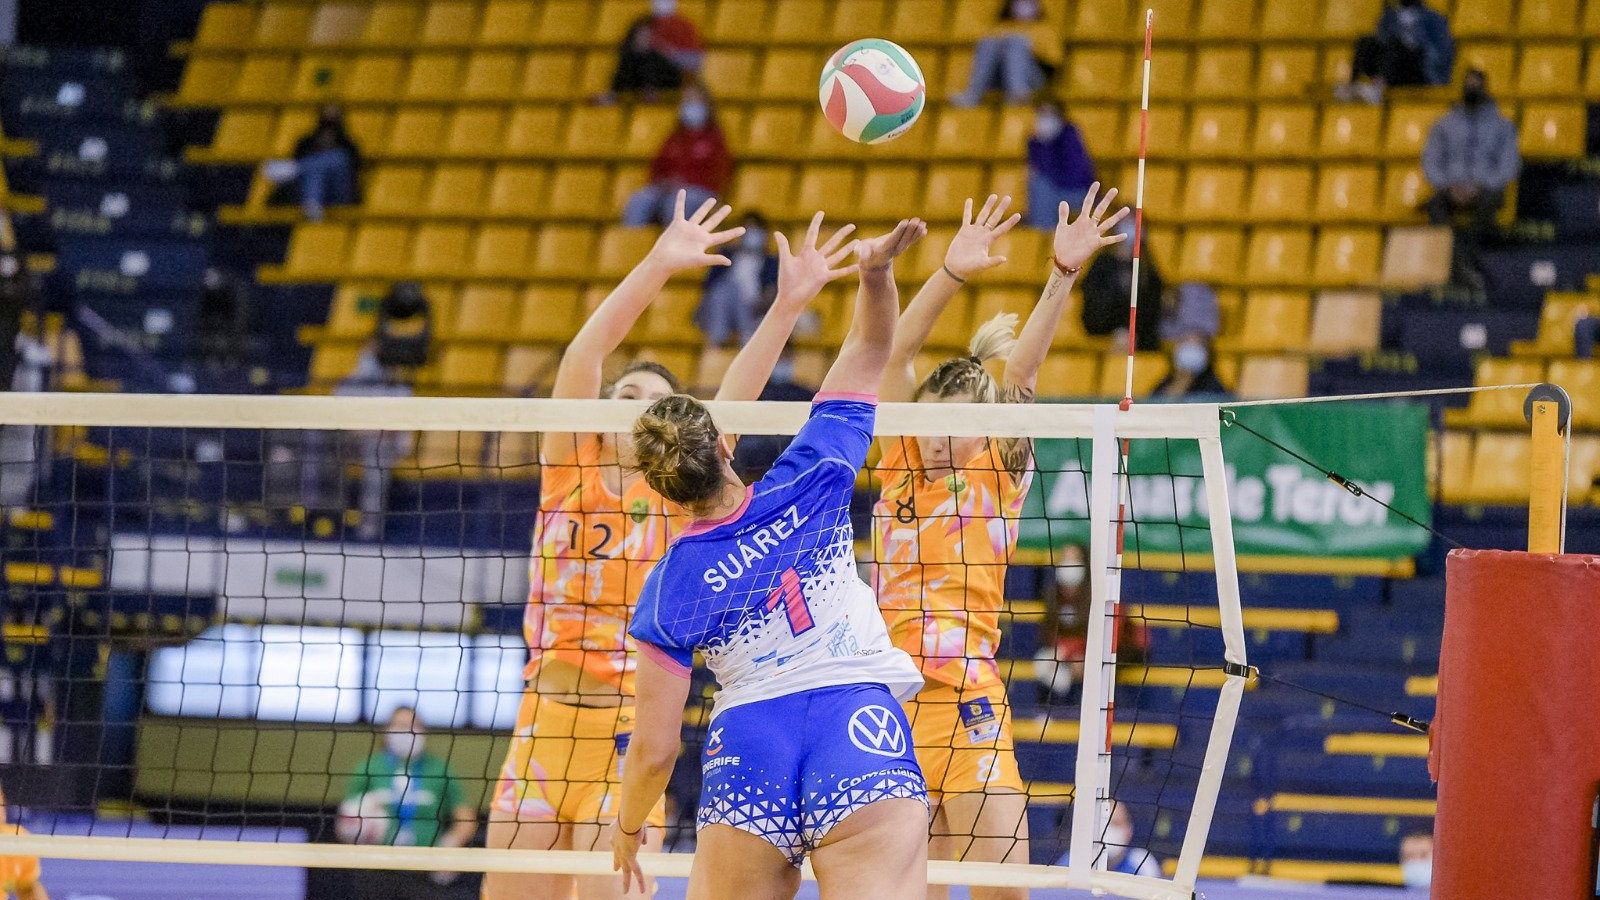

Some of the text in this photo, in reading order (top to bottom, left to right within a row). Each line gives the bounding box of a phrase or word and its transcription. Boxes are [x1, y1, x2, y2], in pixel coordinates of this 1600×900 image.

[896, 496, 916, 524] 8
[1267, 464, 1396, 527] Teror
[568, 519, 613, 560] 12
[703, 504, 809, 593] SUÁREZ
[766, 565, 816, 639] 1
[975, 753, 1001, 783] 8
